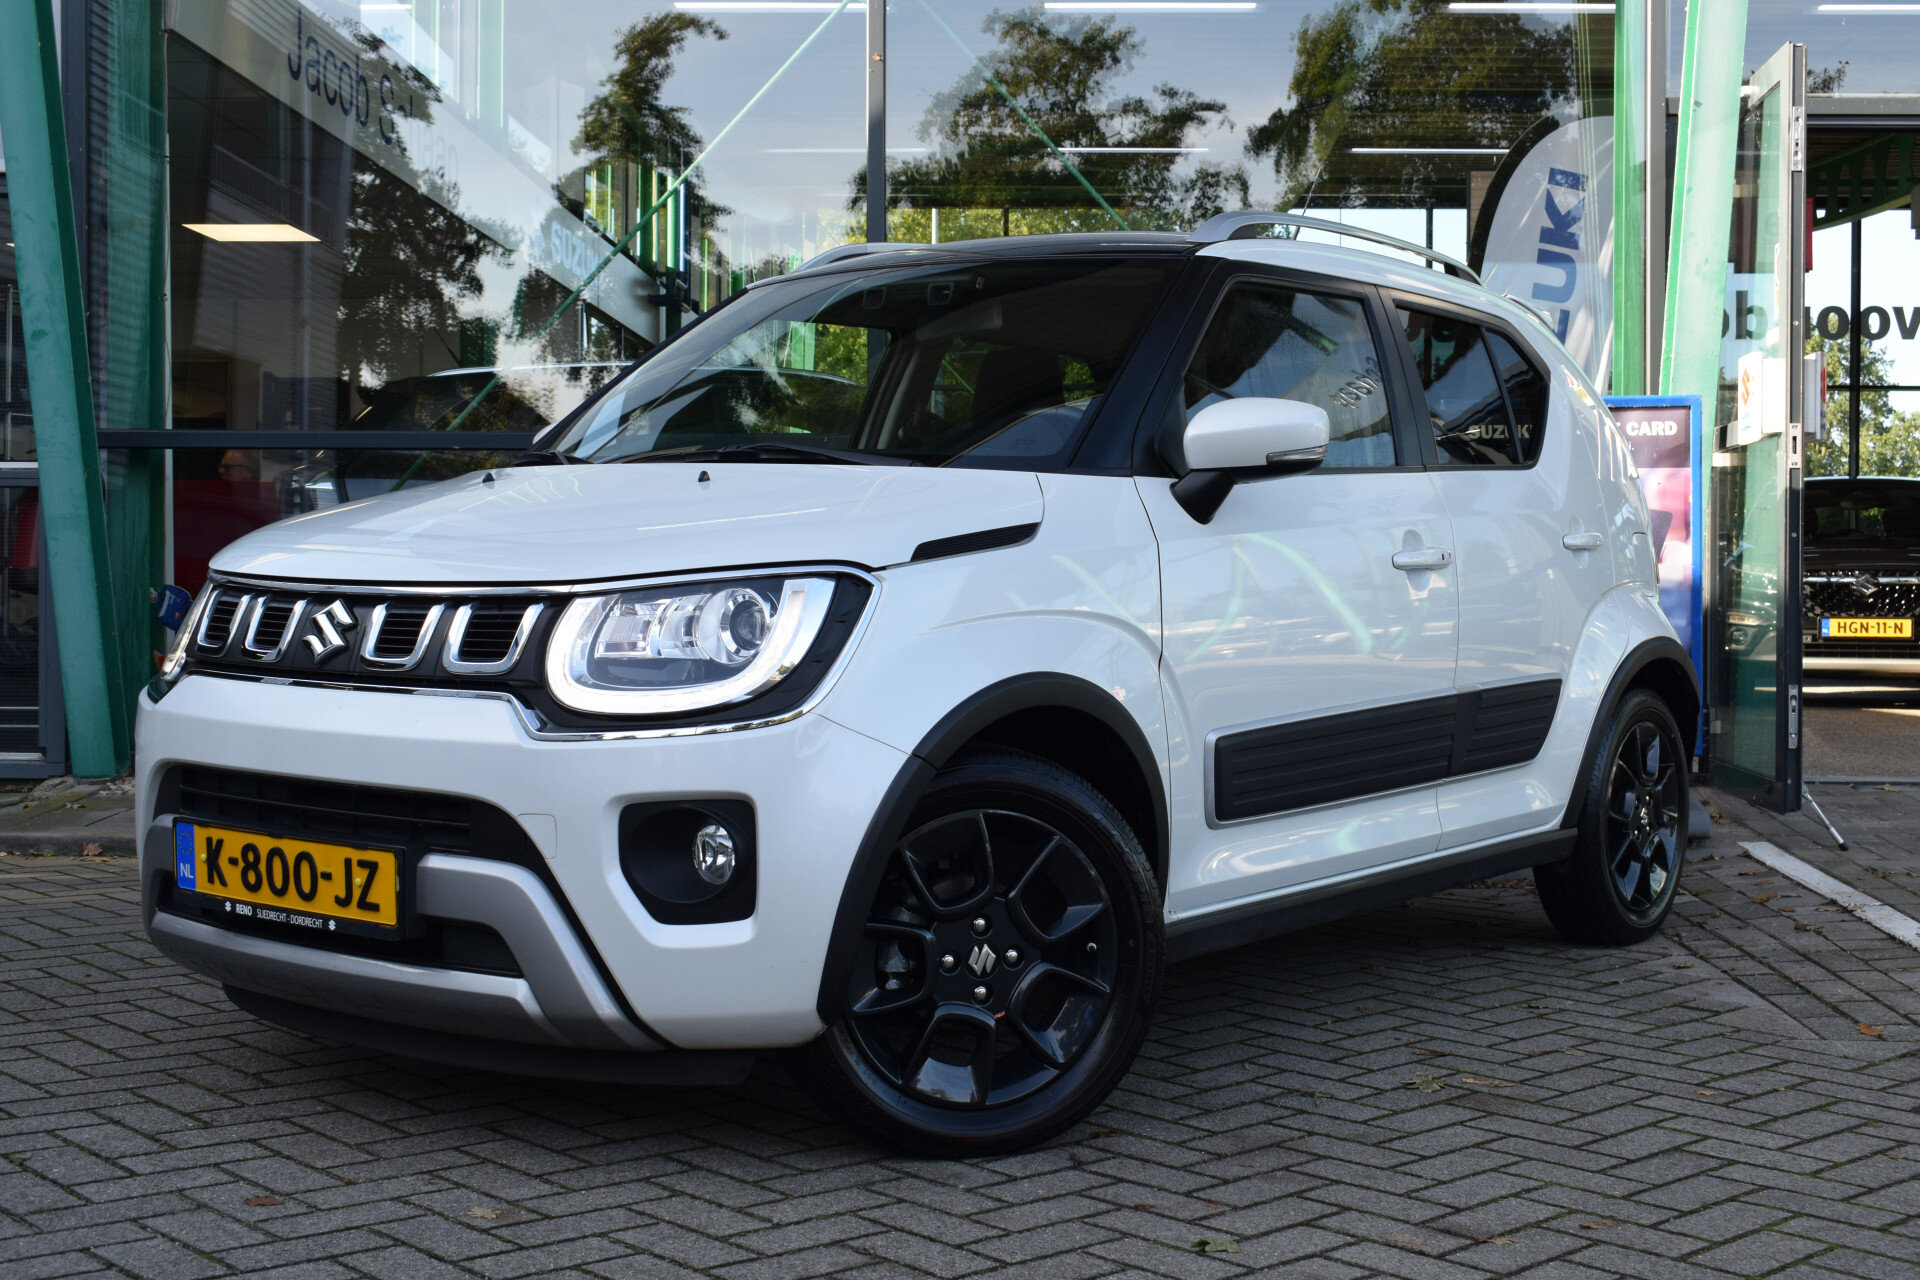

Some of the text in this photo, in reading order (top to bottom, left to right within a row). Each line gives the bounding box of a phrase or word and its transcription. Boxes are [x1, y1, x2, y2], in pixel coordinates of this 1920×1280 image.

[287, 7, 370, 128] Jacob
[1626, 421, 1678, 436] CARD
[1837, 621, 1904, 634] HGN-11-N
[180, 863, 194, 879] NL
[205, 836, 380, 912] K-800-JZ
[235, 903, 253, 916] RENO
